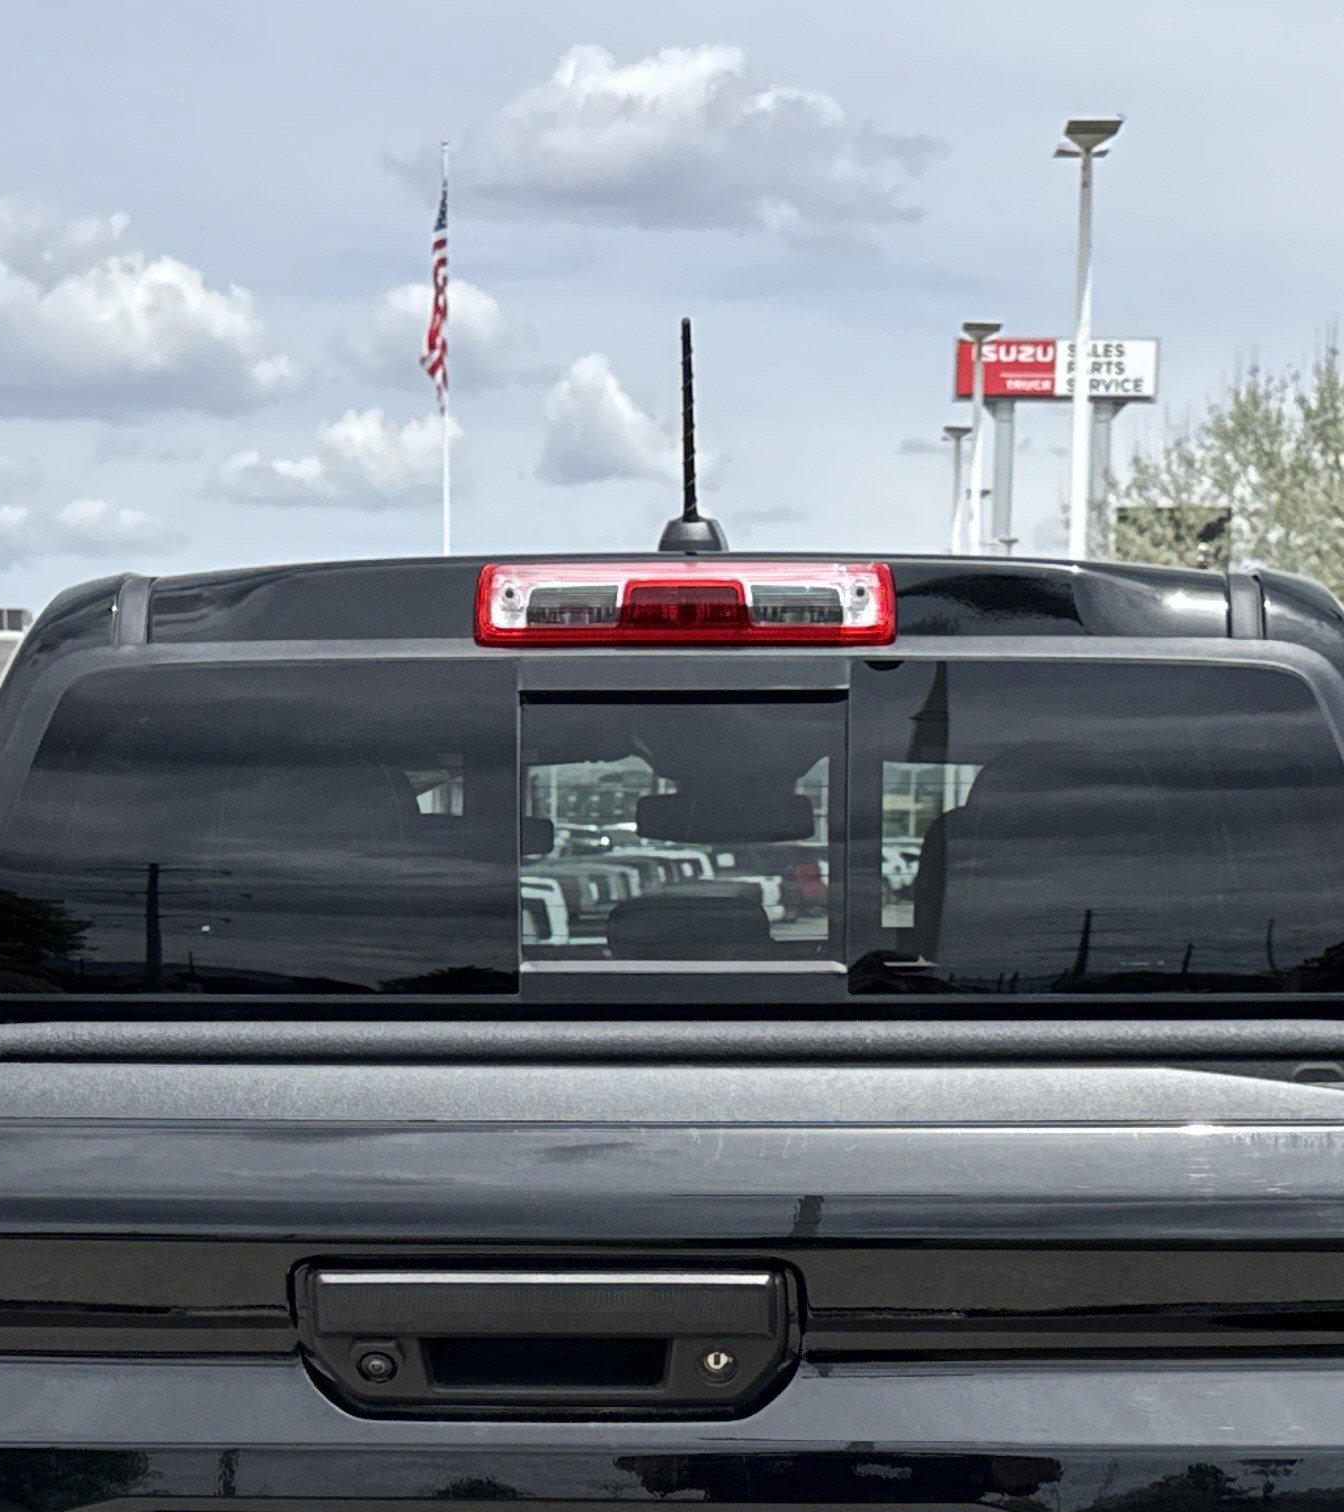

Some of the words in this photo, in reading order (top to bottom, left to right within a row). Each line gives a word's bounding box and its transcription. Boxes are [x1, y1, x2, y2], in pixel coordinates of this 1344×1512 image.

[1067, 343, 1125, 359] SLES
[1066, 360, 1125, 376] PRTS
[1066, 377, 1144, 393] SRVICE
